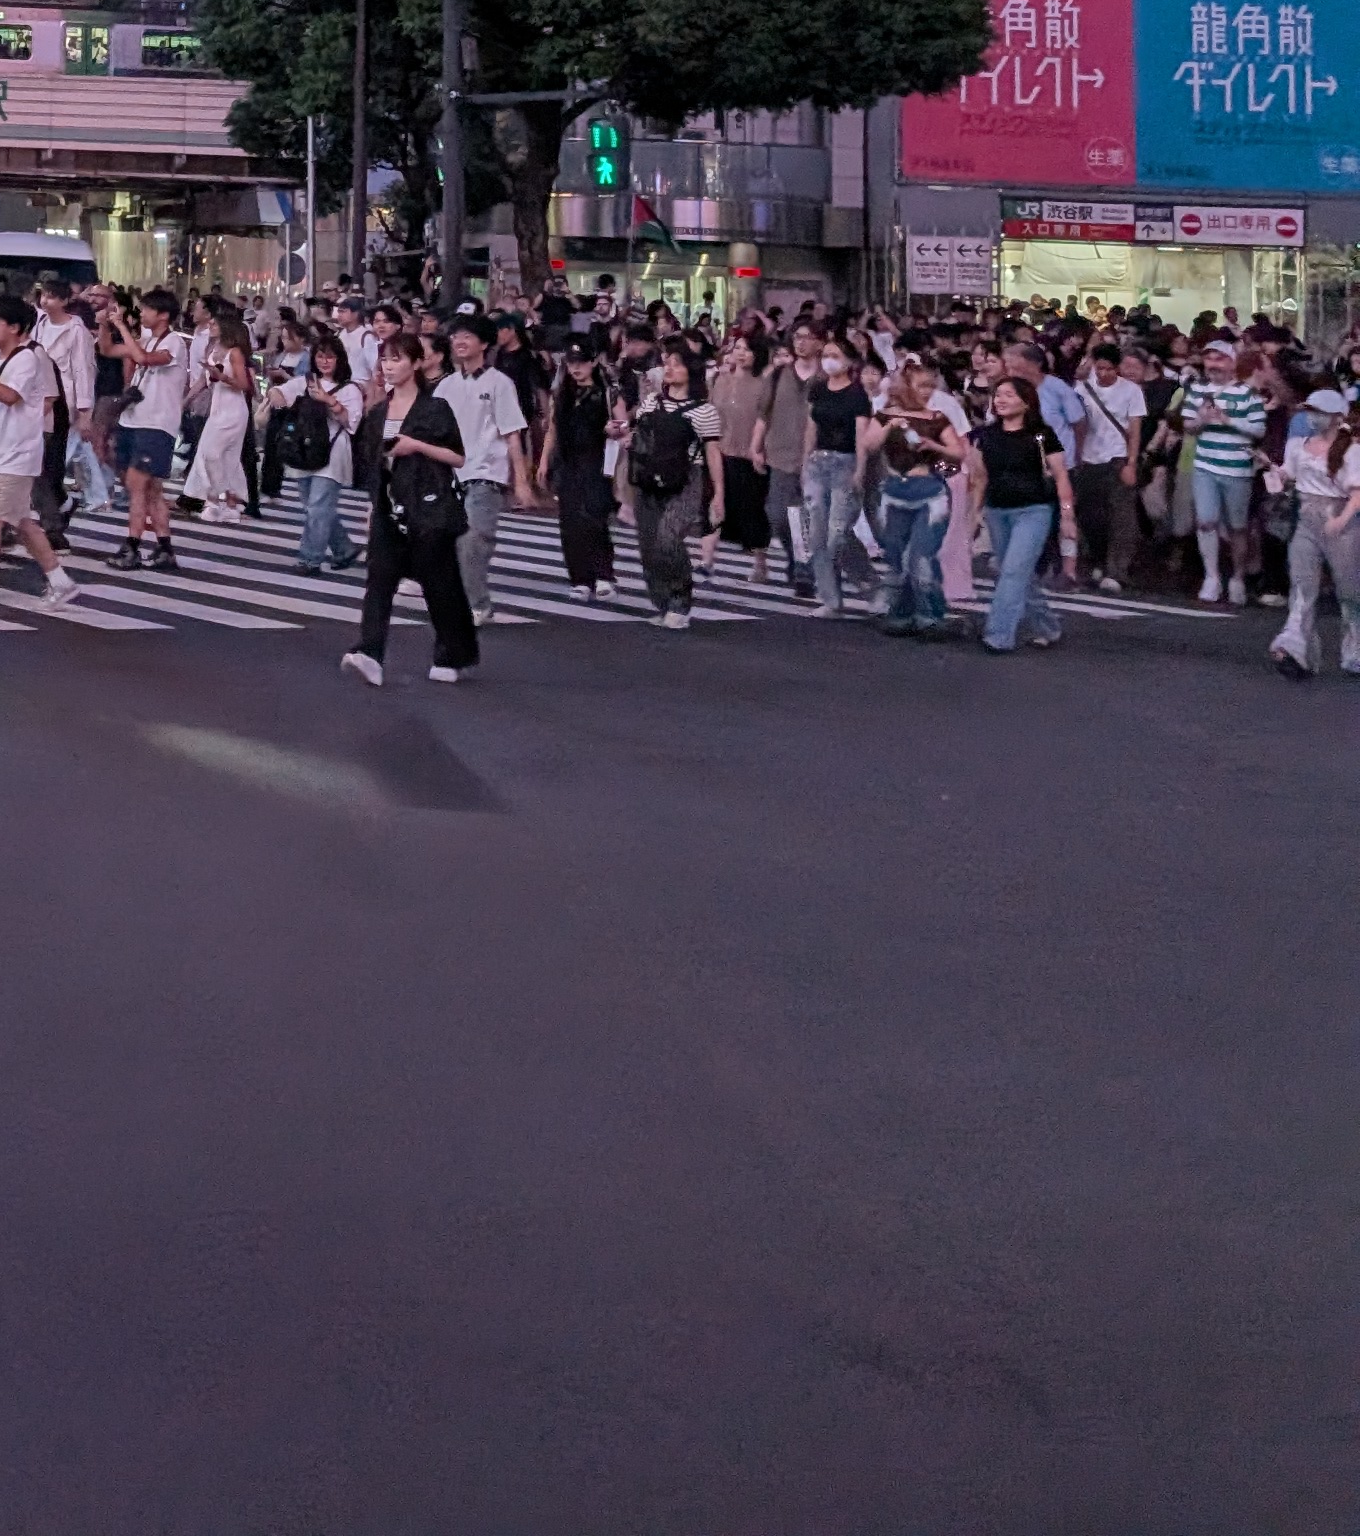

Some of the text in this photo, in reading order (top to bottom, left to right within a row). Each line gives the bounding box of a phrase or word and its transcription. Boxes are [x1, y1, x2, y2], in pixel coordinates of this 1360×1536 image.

[1190, 0, 1314, 56] 龍角散
[1173, 59, 1338, 115] ダイレクト
[1016, 200, 1094, 221] JR 渋谷駅
[1021, 222, 1082, 238] 入口専用
[1207, 214, 1272, 232] 出口専用
